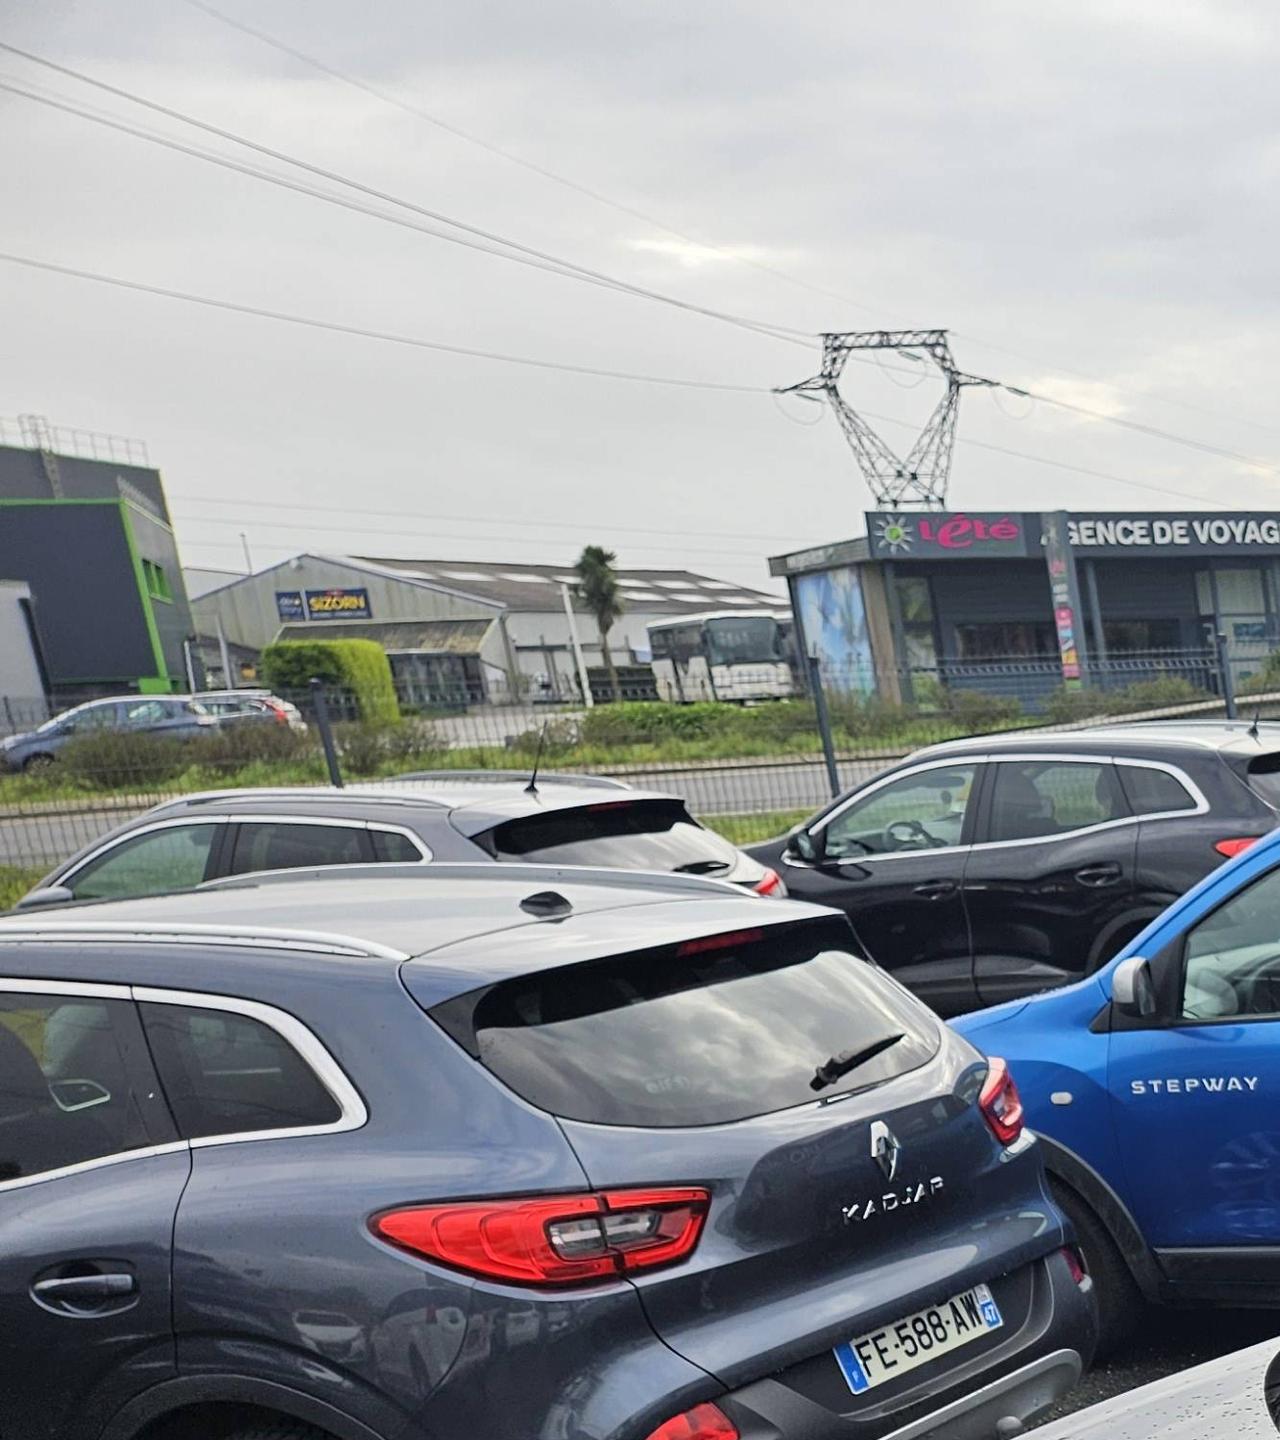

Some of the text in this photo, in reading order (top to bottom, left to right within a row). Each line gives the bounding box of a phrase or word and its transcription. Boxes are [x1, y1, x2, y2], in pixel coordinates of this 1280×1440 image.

[1040, 519, 1150, 546] GENCE
[1152, 519, 1190, 545] DE
[1130, 1076, 1258, 1095] STEPWAY
[854, 1287, 983, 1378] FE-588-AW
